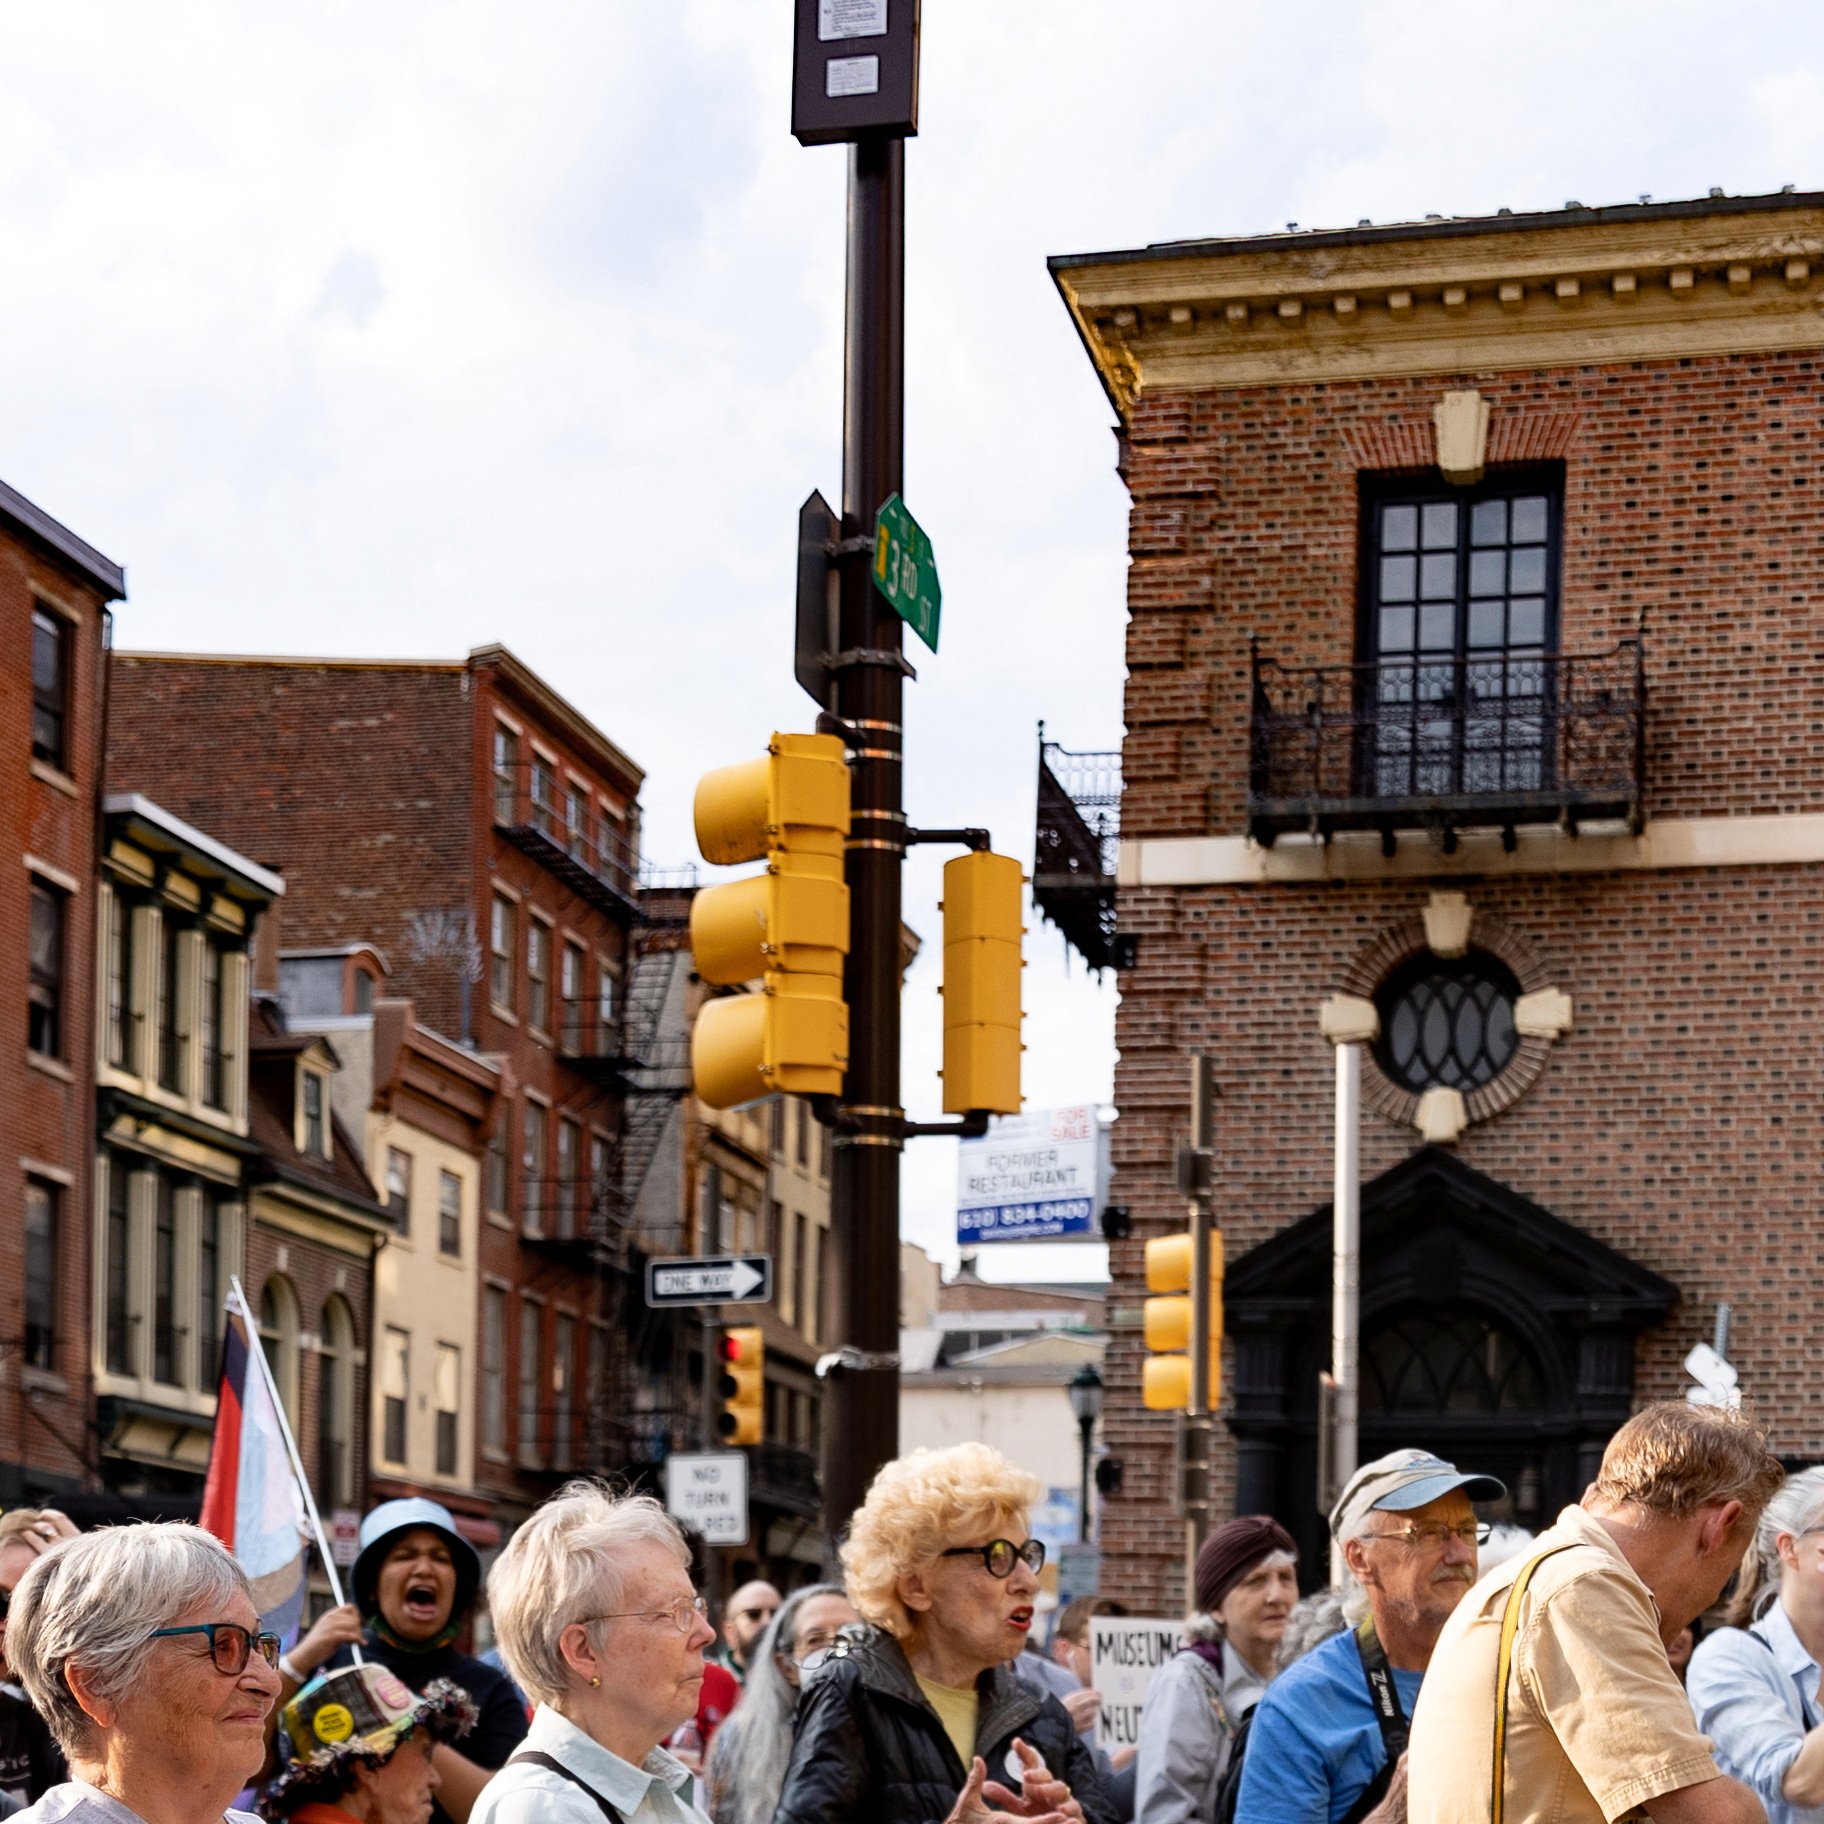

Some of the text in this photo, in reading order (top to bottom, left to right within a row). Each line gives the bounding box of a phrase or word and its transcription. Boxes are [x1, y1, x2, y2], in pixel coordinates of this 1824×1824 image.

[886, 538, 918, 601] 3RD
[1056, 1108, 1088, 1125] FOR
[1050, 1125, 1091, 1143] SALE
[987, 1149, 1059, 1172] FORMER
[967, 1166, 1078, 1194] RESTAURANT
[662, 1275, 695, 1293] ONE
[692, 1465, 722, 1484] NO
[685, 1490, 731, 1510] TURN
[704, 1514, 737, 1534] RED
[1379, 1684, 1395, 1717] Nikon
